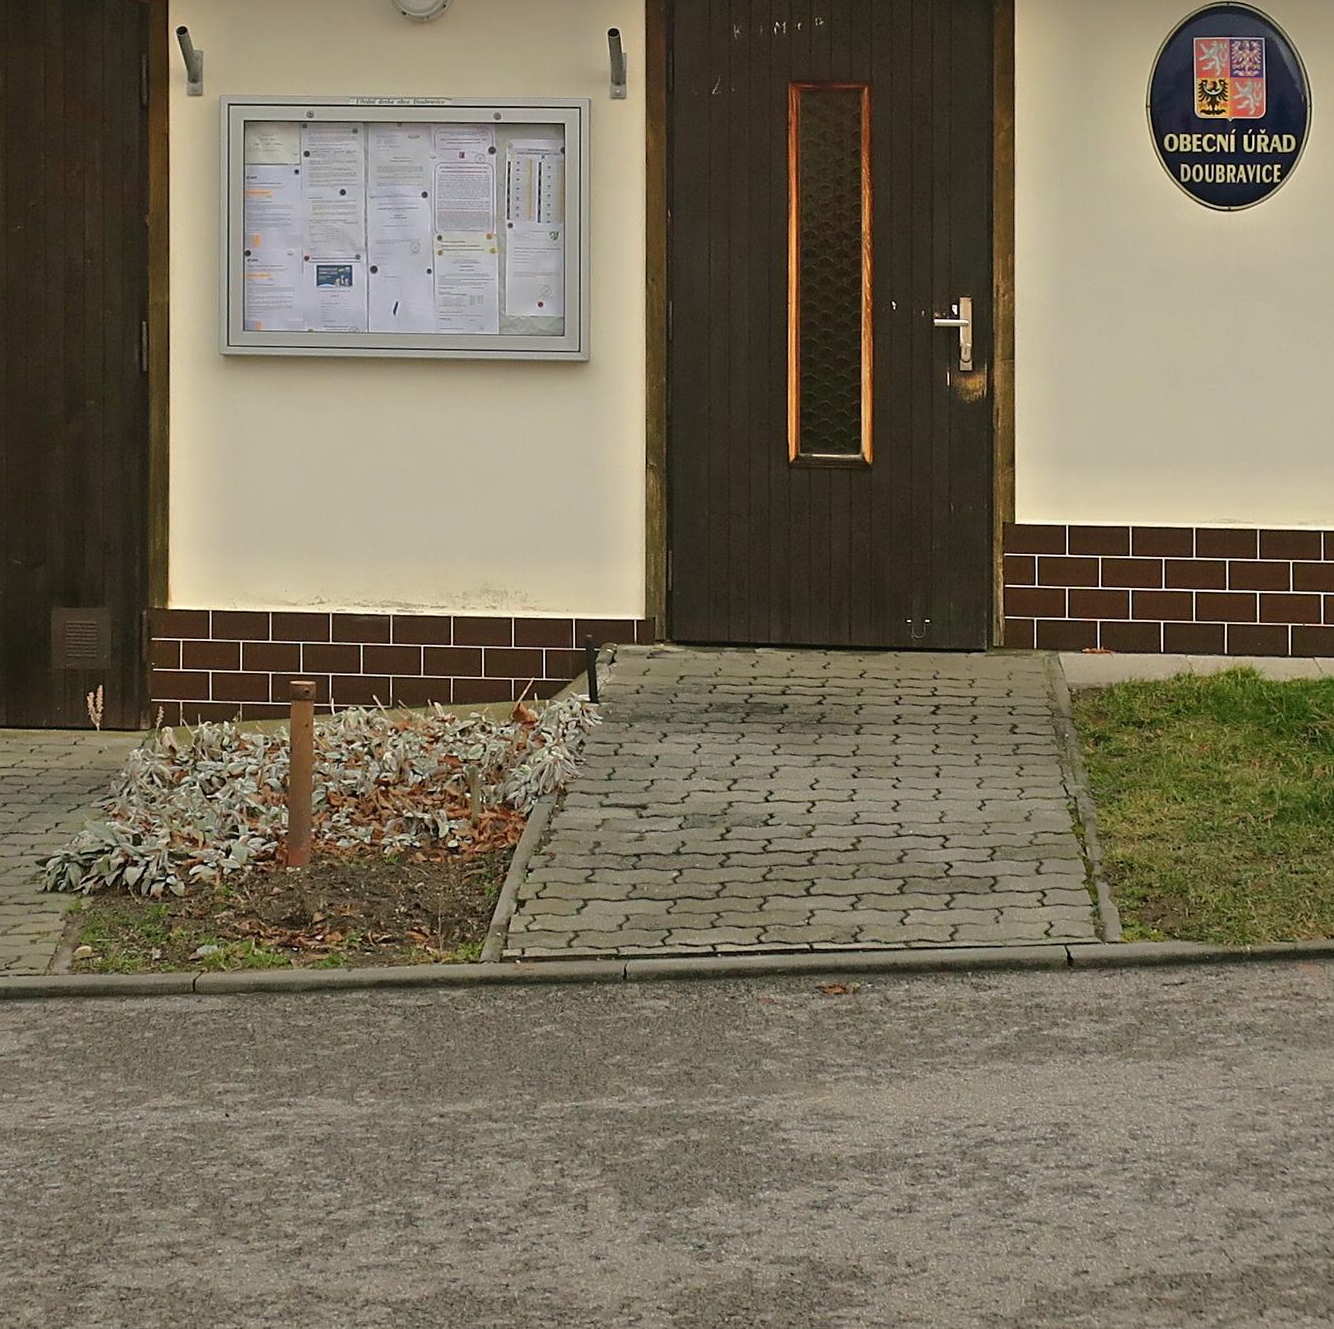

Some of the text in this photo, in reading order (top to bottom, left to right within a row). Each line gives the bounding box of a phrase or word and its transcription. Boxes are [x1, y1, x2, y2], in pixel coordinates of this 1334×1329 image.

[1163, 129, 1297, 153] OBECNÍ ÚŘAD
[1180, 163, 1282, 183] DOUBRAVICE
